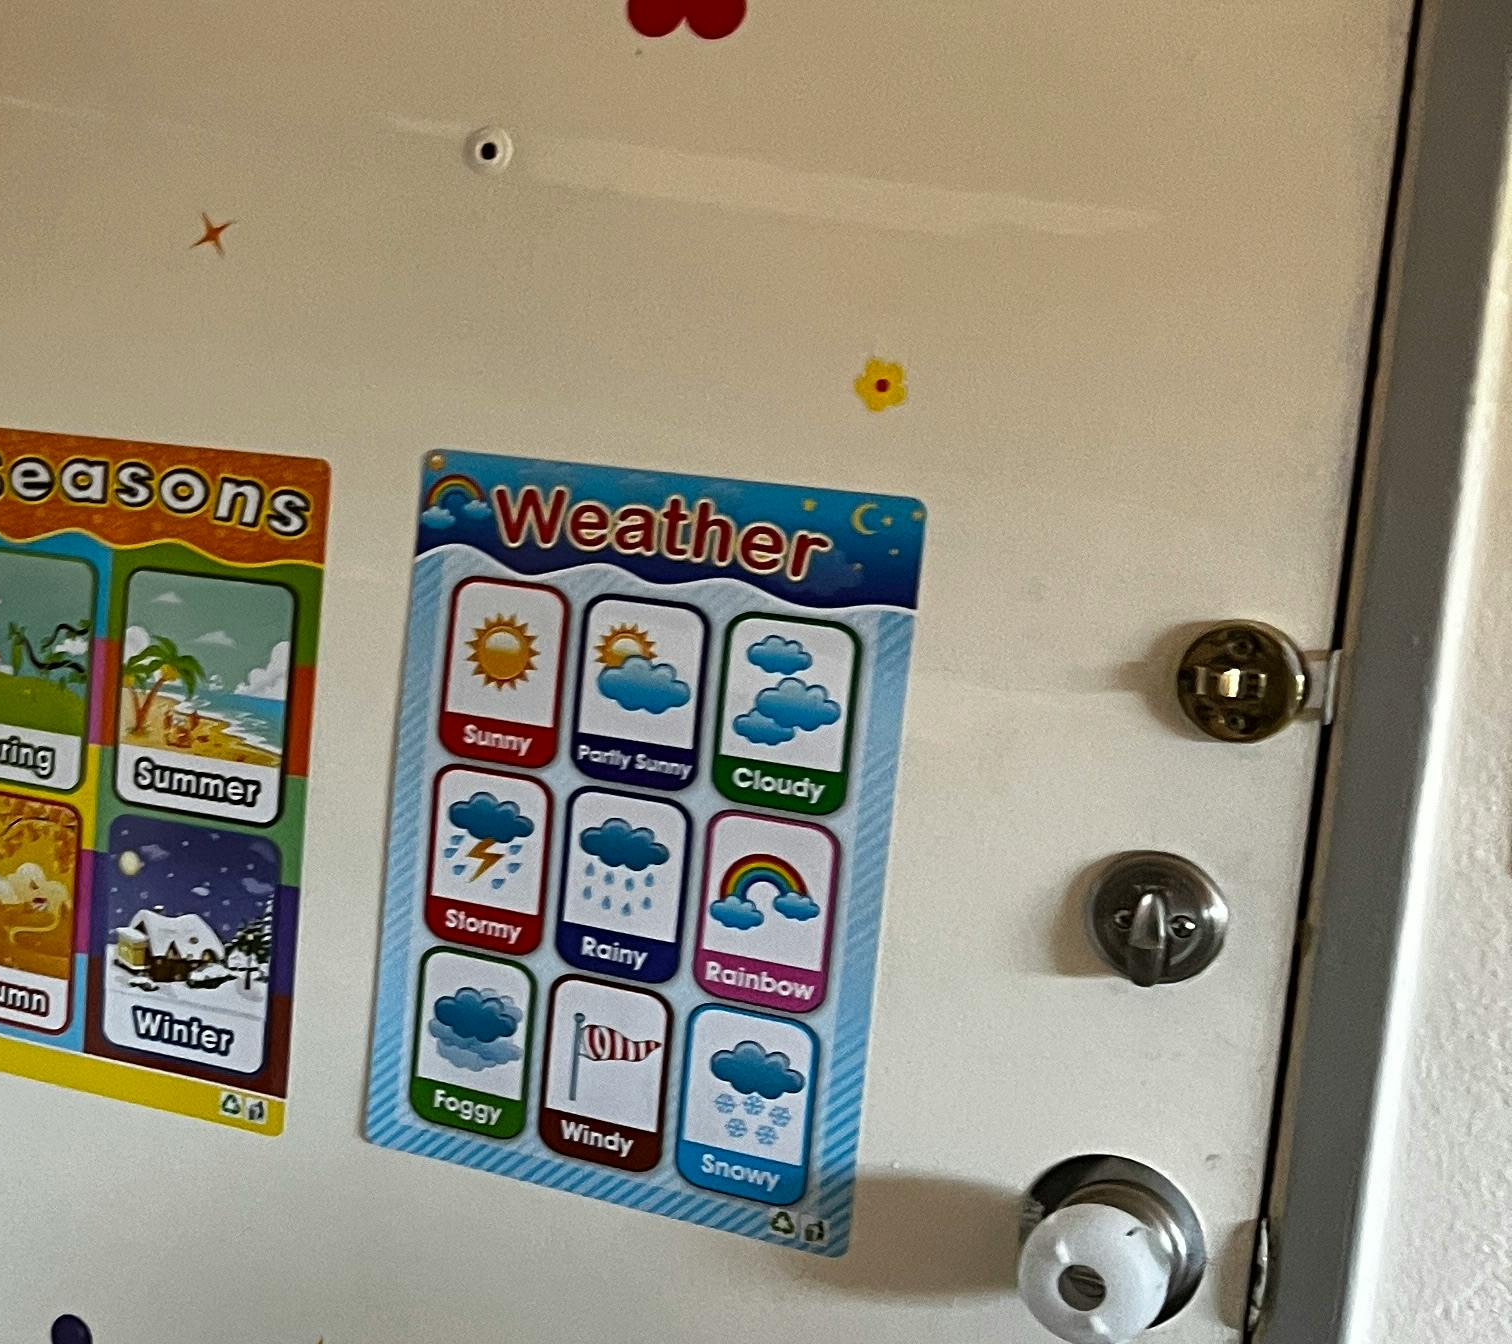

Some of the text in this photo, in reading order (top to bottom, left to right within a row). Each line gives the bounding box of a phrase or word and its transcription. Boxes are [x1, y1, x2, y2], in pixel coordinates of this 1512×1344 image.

[491, 484, 834, 581] Weather
[461, 723, 534, 758] Sunny
[133, 756, 261, 806] Summer
[576, 743, 693, 783] Partly Sunny
[731, 766, 826, 806] Cloudy
[444, 909, 523, 945] Stormy
[581, 936, 649, 972] Rainy
[704, 960, 816, 1003] Rainbow
[132, 1006, 234, 1057] Winter
[432, 1088, 504, 1128] Foggy
[559, 1119, 635, 1157] Windy
[700, 1153, 782, 1194] Snowy
